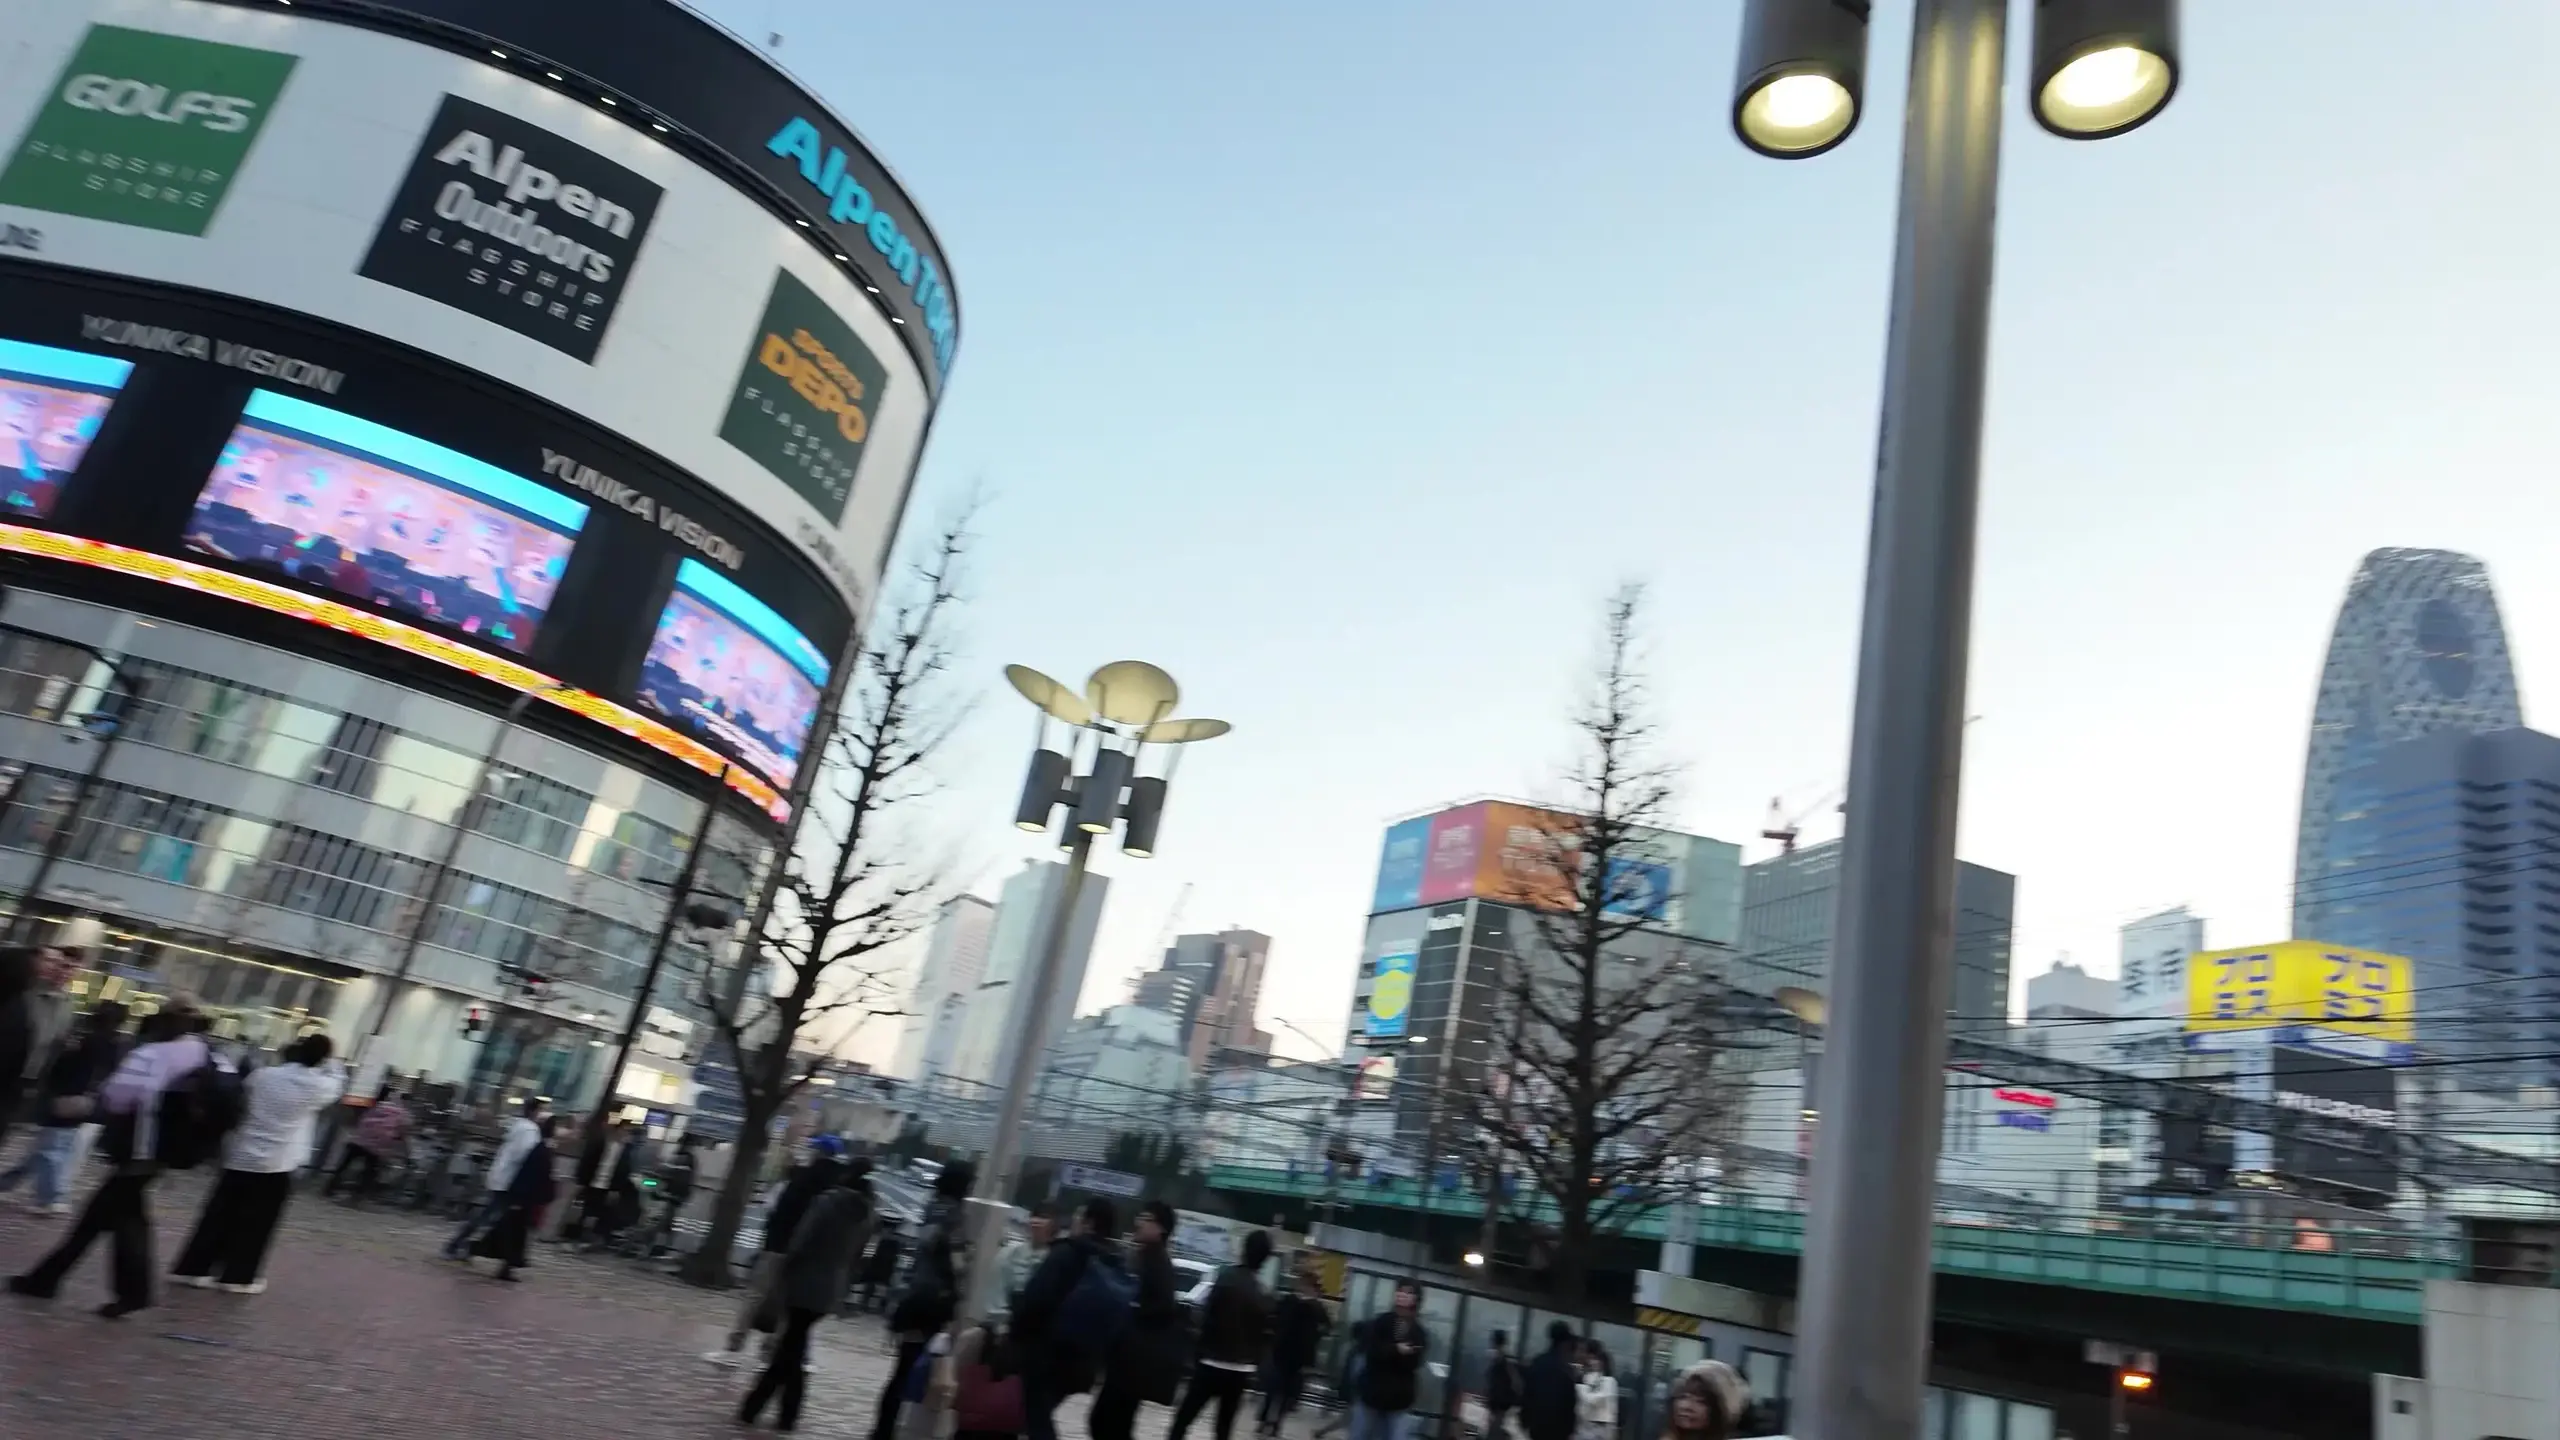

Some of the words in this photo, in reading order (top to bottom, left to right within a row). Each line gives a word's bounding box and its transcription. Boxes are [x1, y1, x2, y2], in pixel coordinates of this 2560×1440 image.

[25, 138, 224, 184] FLAGSHIP
[83, 173, 210, 210] STORE
[434, 128, 637, 240] Alpen
[398, 216, 604, 308] FLAGSHIP
[436, 180, 613, 283] Outdoors
[466, 267, 594, 333] STORE
[82, 313, 210, 362] YUNIKA
[214, 338, 346, 396] VISION
[758, 333, 867, 443] DEPO
[541, 447, 656, 524] YUNIKA
[658, 505, 746, 571] VISION
